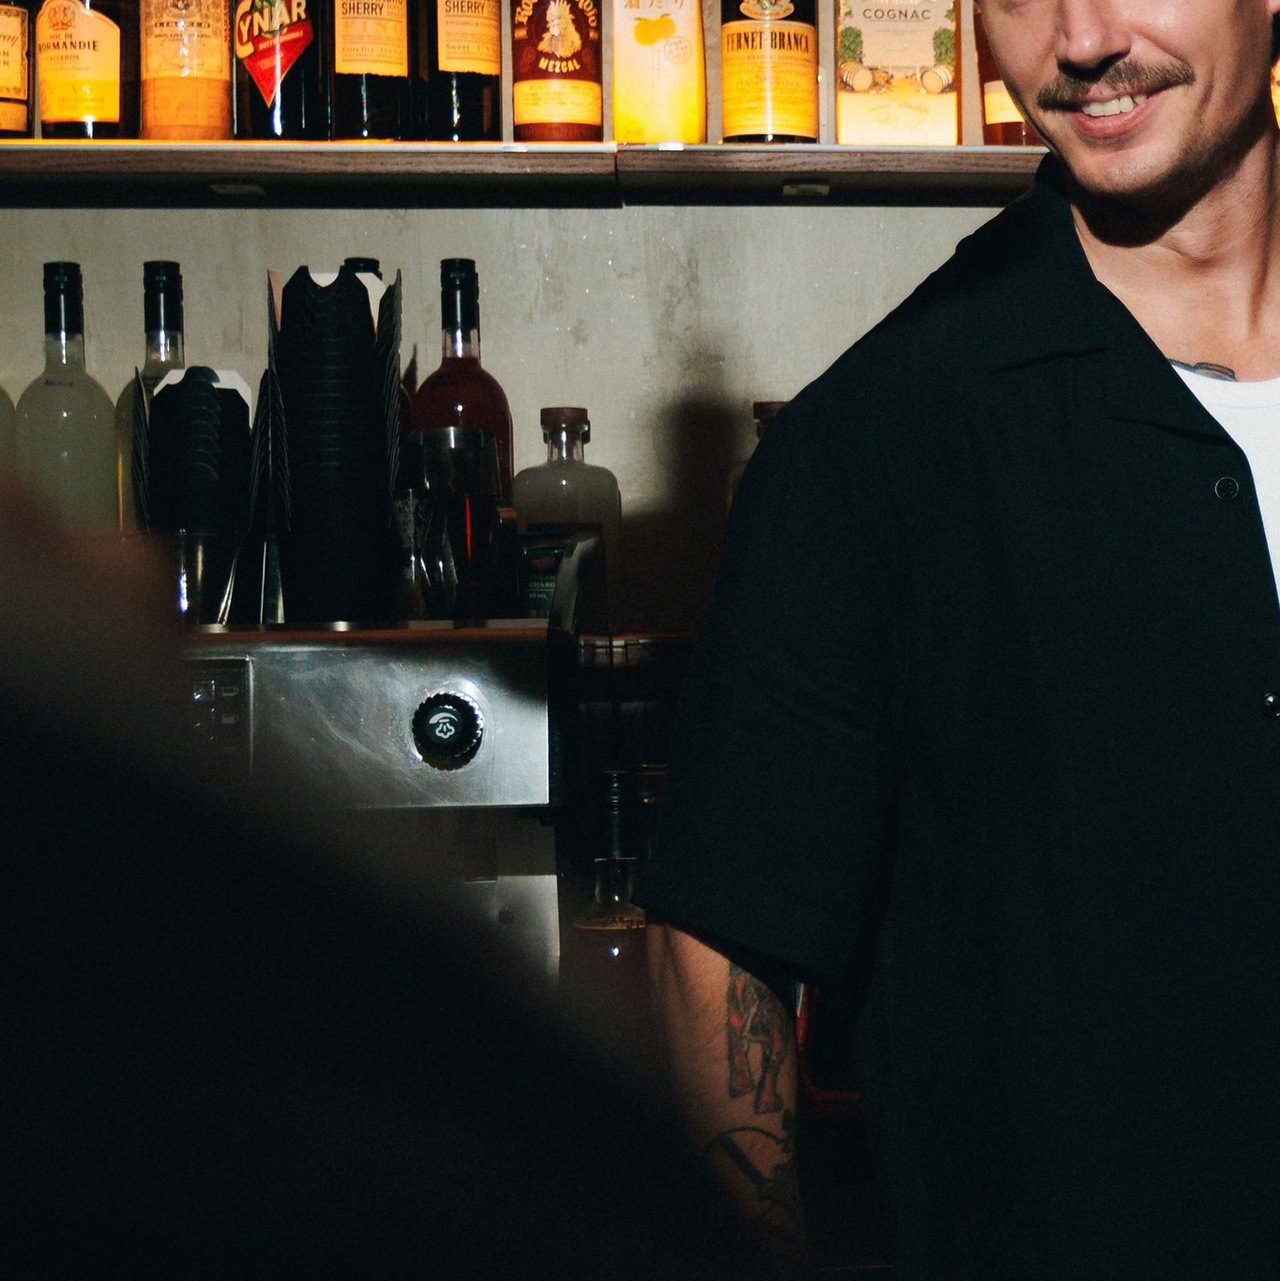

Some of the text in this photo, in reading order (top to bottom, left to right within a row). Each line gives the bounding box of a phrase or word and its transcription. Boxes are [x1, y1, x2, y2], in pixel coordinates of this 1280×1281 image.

[341, 2, 384, 16] SHERRY
[445, 0, 486, 14] SHERRY
[863, 8, 931, 20] COGNAC
[538, 57, 581, 73] MEZCAL
